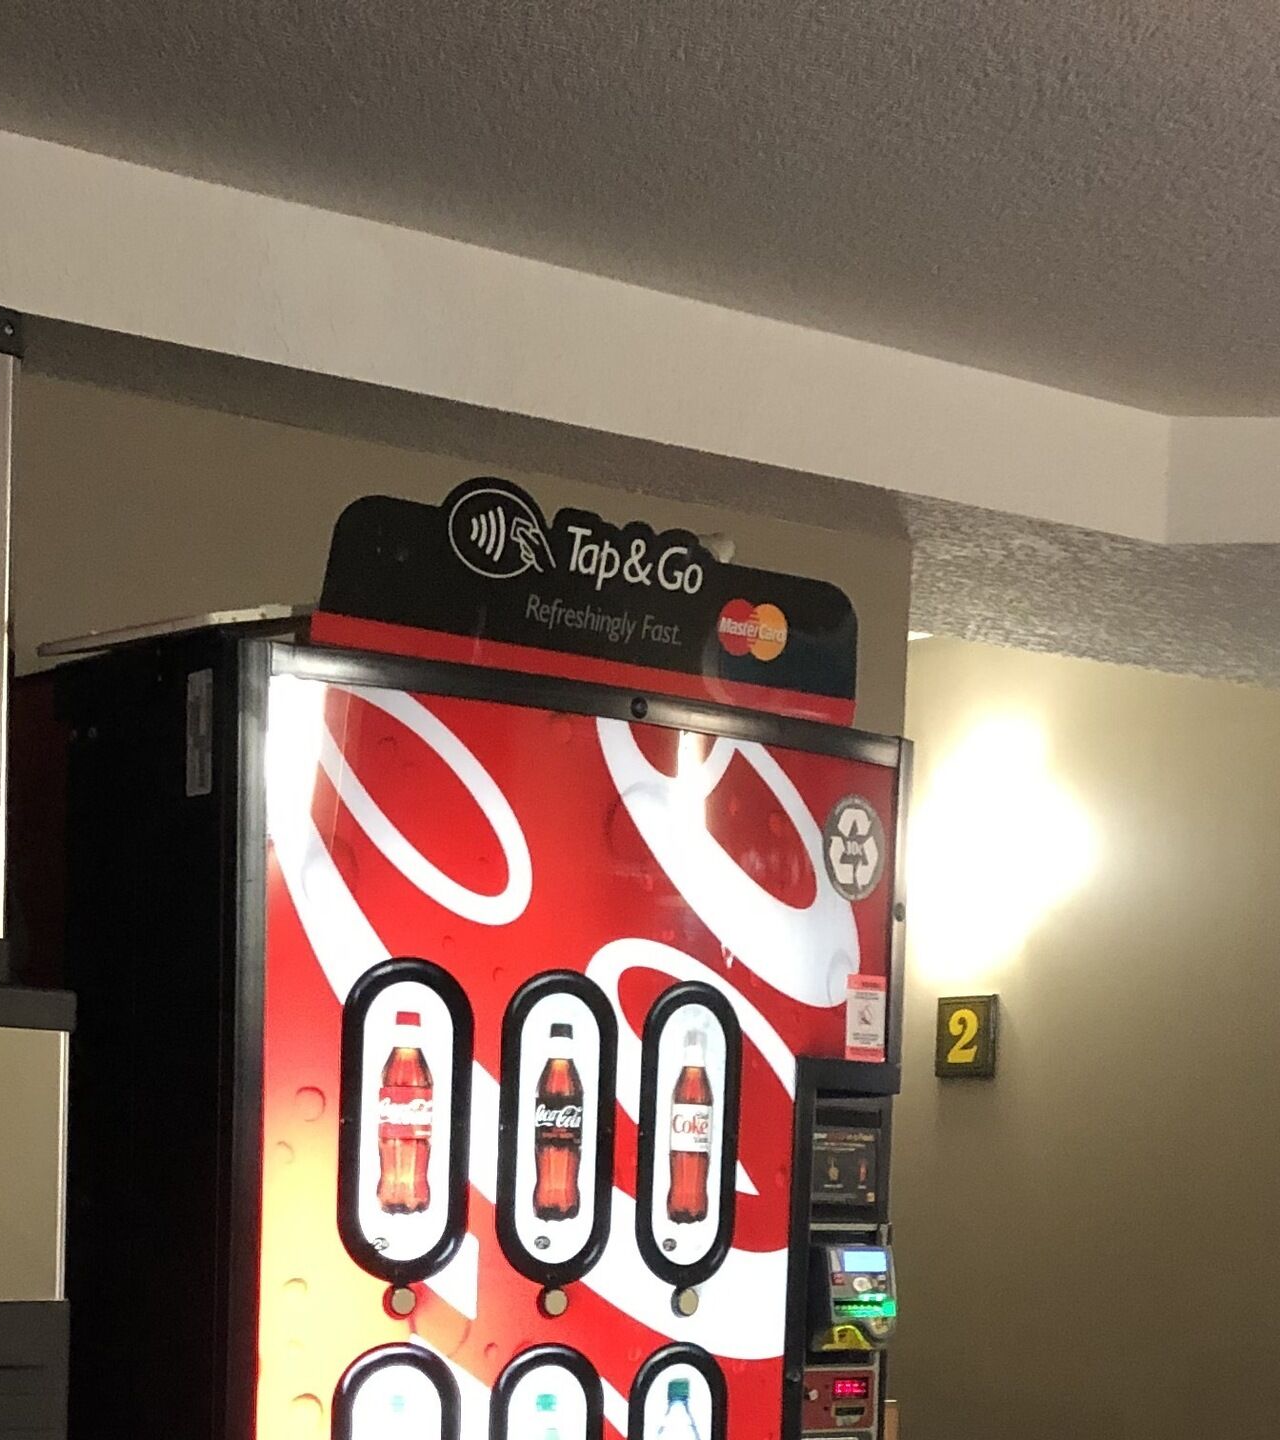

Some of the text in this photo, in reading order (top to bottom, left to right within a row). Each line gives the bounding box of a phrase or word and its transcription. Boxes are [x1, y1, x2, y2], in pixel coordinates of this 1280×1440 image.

[525, 594, 682, 645] Refreshingly Fast.
[719, 616, 788, 642] MasterCard
[947, 1008, 978, 1064] 2
[672, 1114, 709, 1134] Coke
